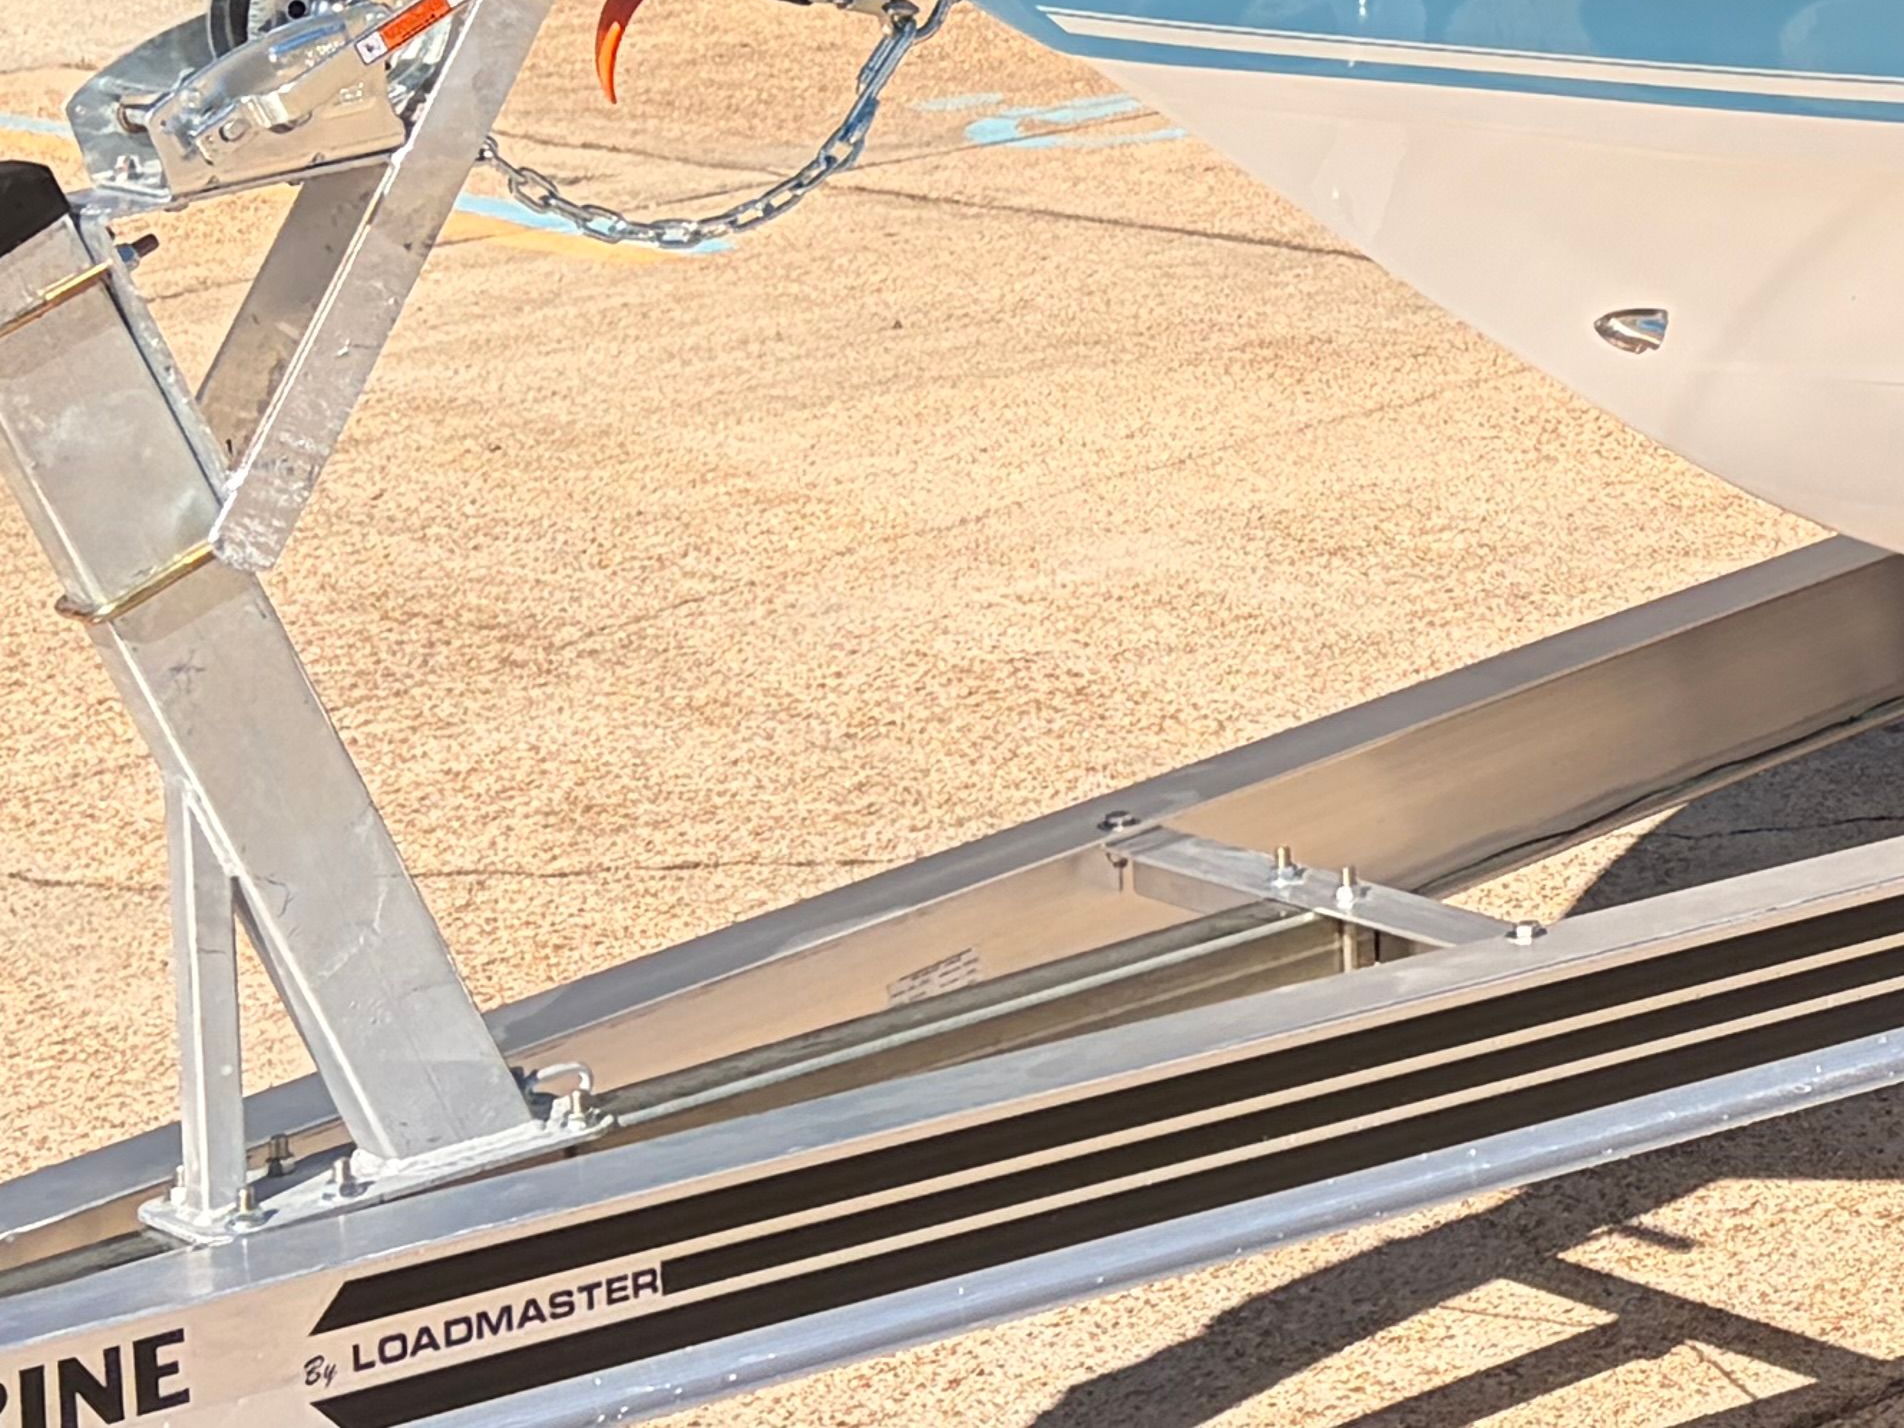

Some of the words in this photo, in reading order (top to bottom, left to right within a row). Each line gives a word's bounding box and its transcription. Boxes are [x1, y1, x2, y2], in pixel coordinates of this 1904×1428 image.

[0, 1328, 190, 1428] INE
[304, 1355, 338, 1388] By
[352, 1267, 660, 1372] LOADMASTER
